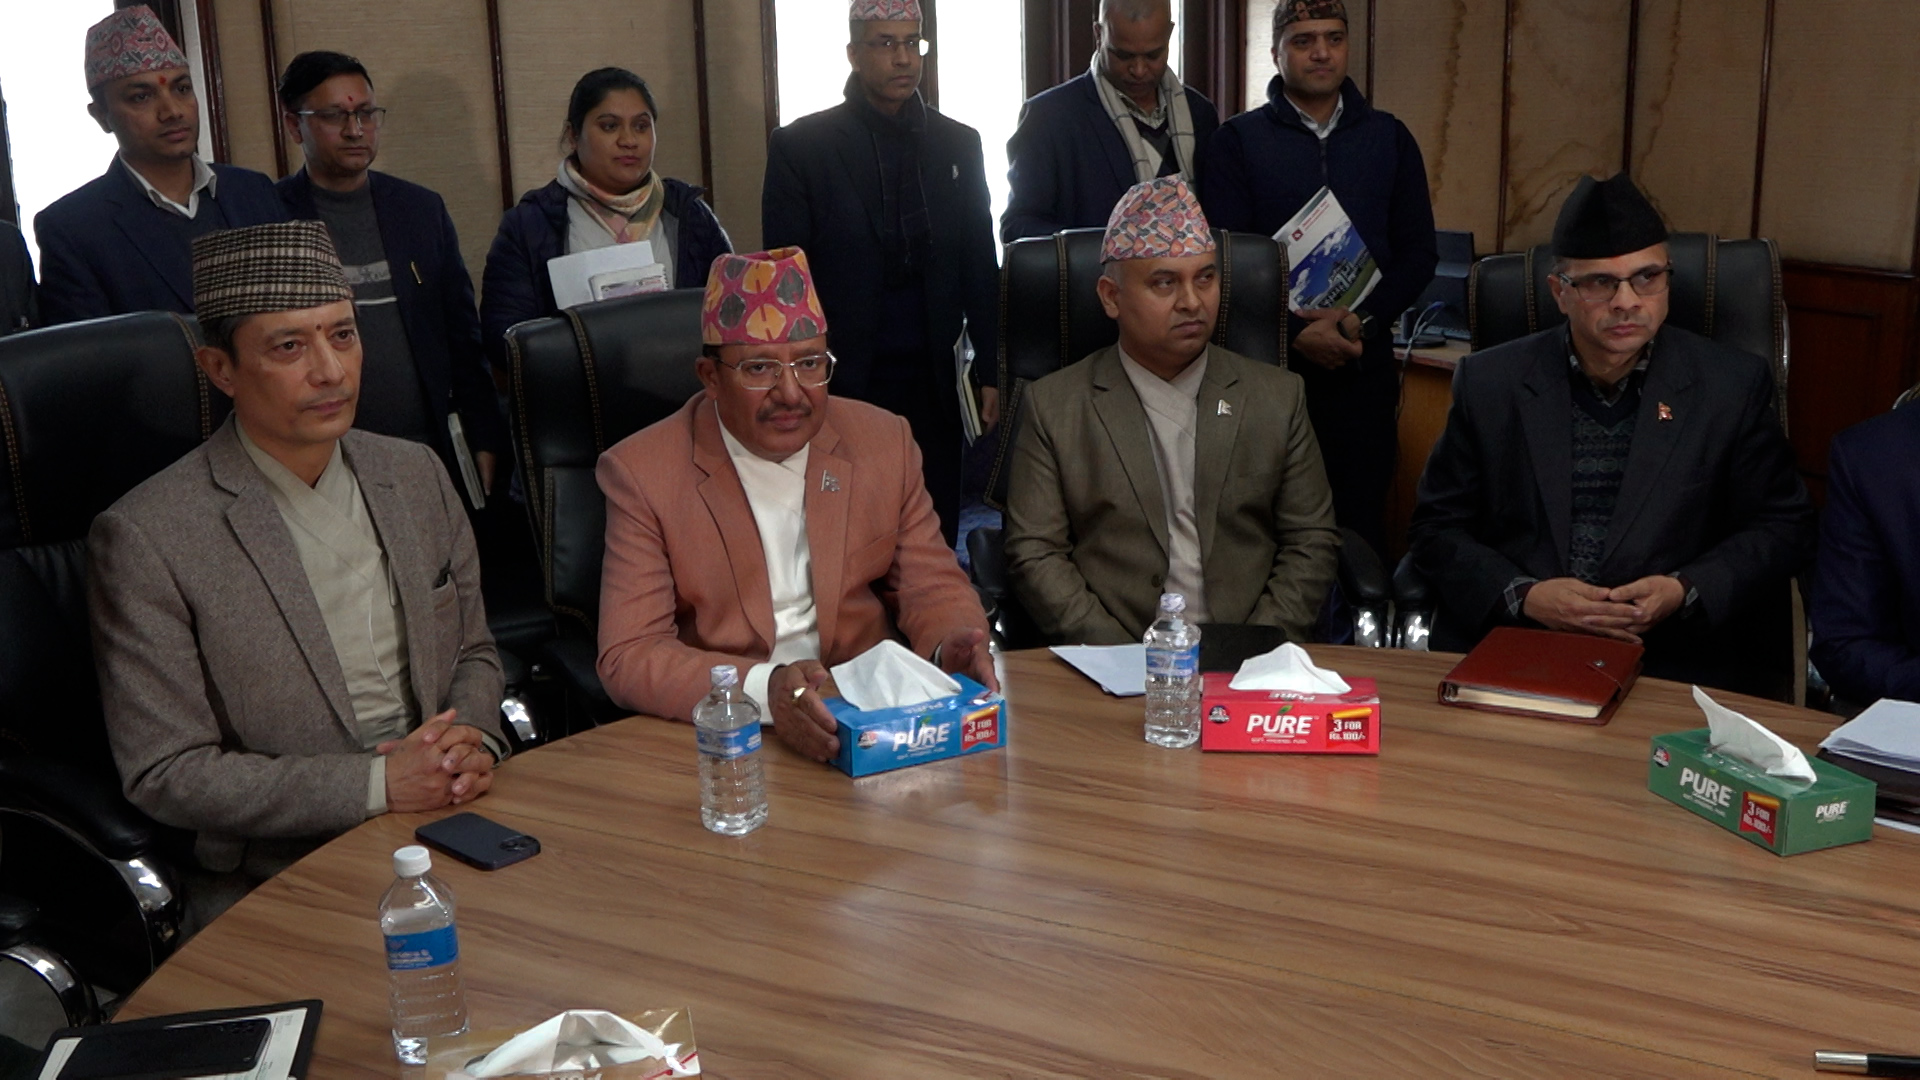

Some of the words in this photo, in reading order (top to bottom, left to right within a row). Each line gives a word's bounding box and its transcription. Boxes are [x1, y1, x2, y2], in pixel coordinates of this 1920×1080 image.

[968, 720, 976, 733] 3
[1246, 714, 1313, 735] PURE
[1333, 719, 1342, 732] 3
[1344, 720, 1362, 730] FOR
[893, 722, 951, 751] PURE
[1679, 767, 1733, 808] PURE
[1747, 801, 1755, 816] 3
[1815, 801, 1848, 818] PURE
